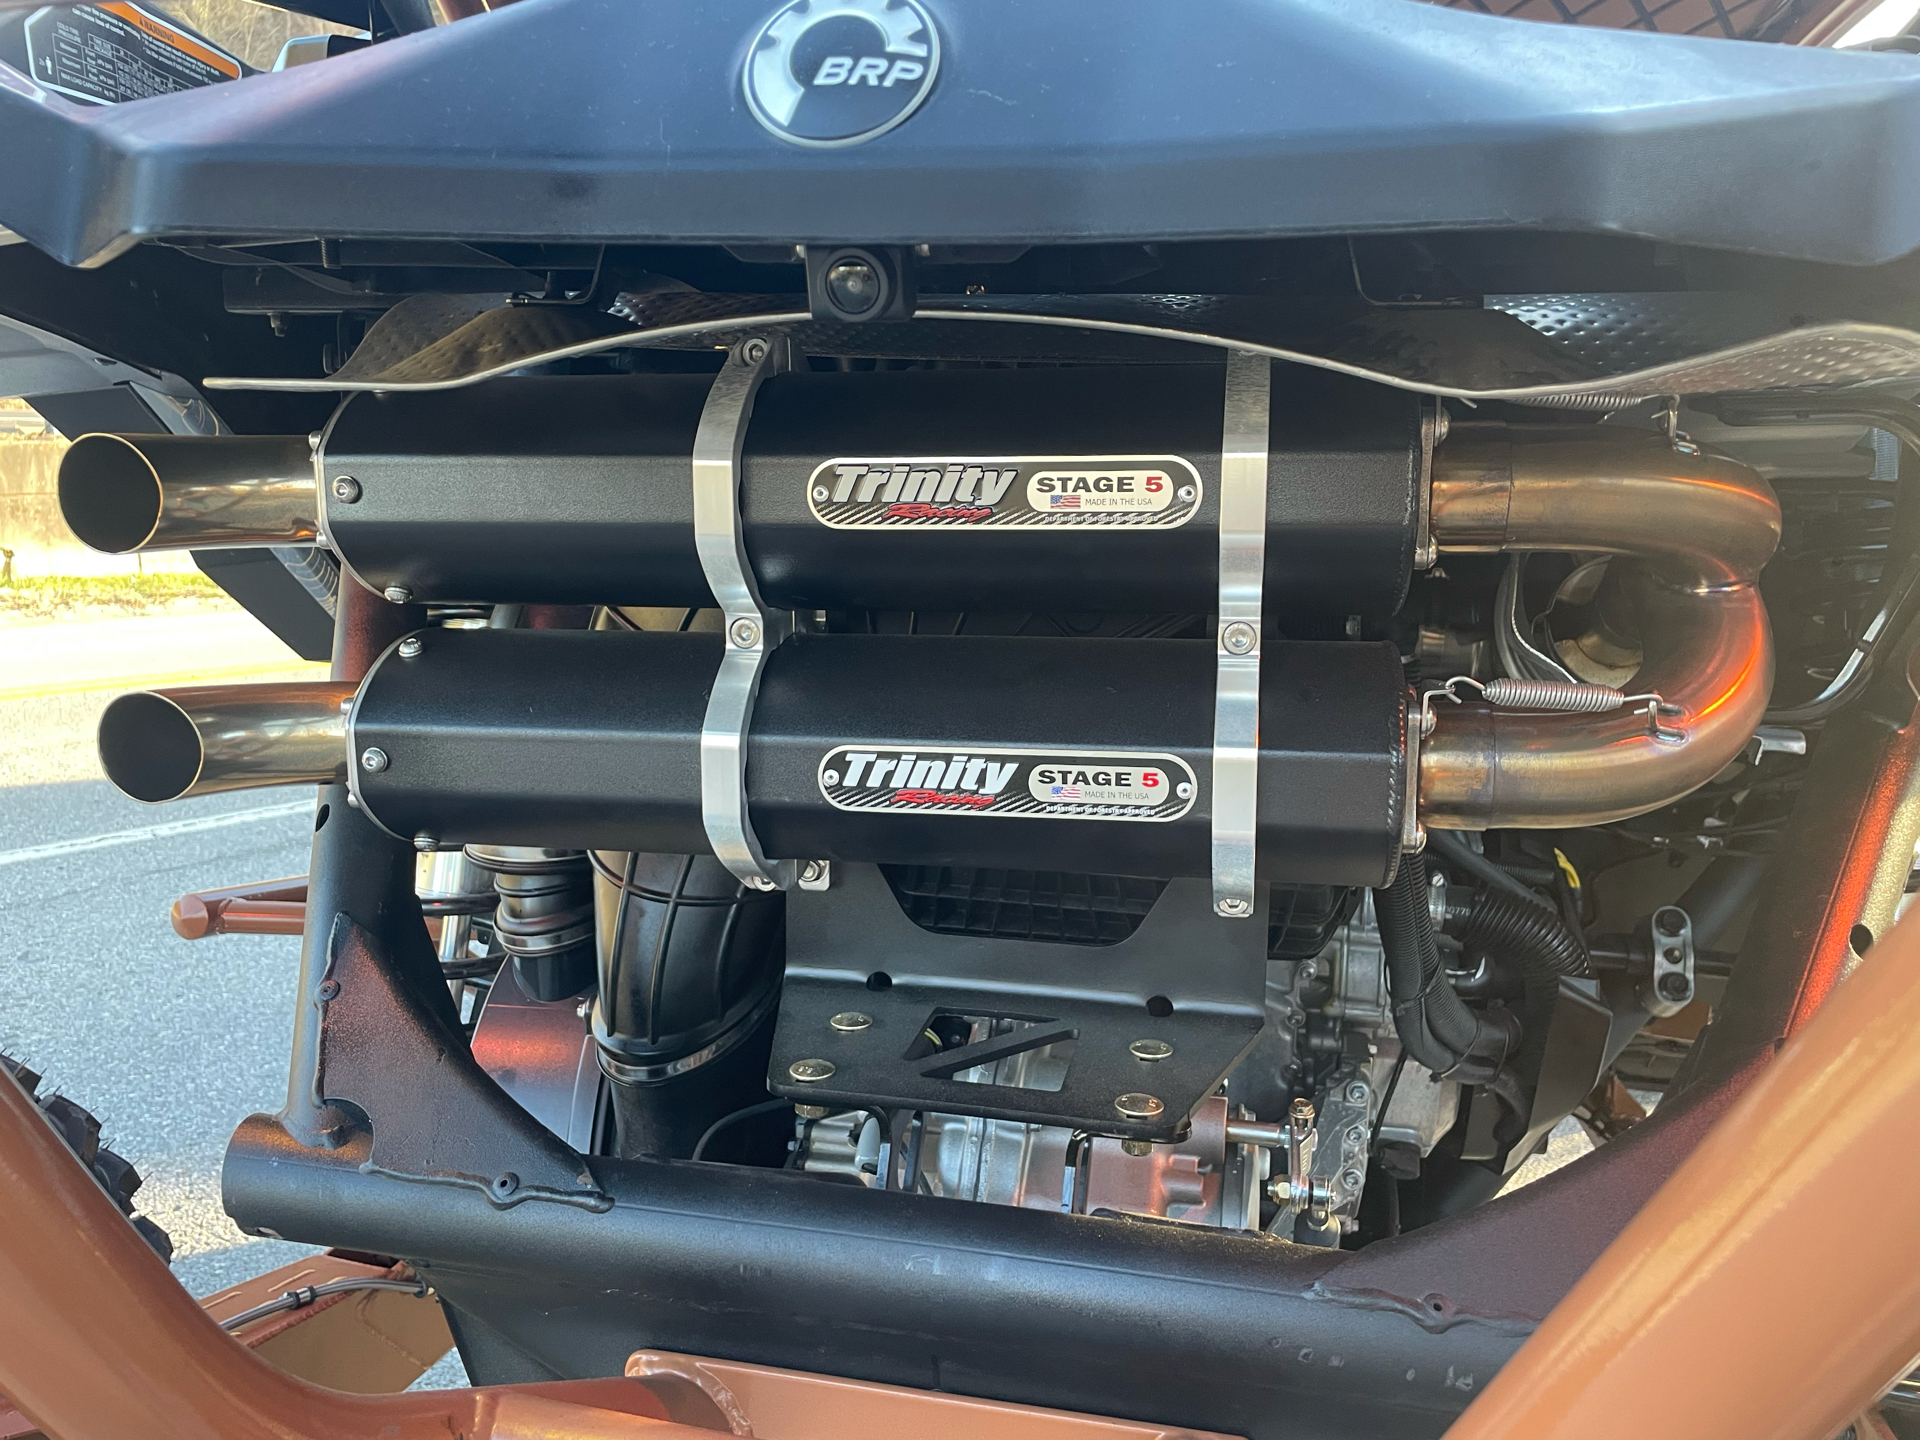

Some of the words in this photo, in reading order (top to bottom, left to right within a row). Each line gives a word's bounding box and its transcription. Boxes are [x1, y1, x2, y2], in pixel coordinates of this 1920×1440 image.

[144, 21, 175, 43] WARNING
[813, 56, 924, 87] BRP
[832, 464, 1018, 506] Trinity
[1036, 476, 1134, 493] STAGE
[1144, 476, 1164, 493] 5
[1085, 498, 1106, 506] MADE
[1109, 498, 1117, 506] IN
[1119, 498, 1136, 506] THE
[1137, 498, 1153, 506] USA
[882, 503, 993, 523] Racing
[842, 752, 1019, 794] Trinity
[1037, 769, 1132, 787] STAGE
[1141, 772, 1160, 788] 5
[891, 788, 996, 809] Racing
[1084, 790, 1106, 798] MADE
[1107, 791, 1116, 799] IN
[1118, 792, 1134, 800] THE
[1134, 792, 1150, 800] USA
